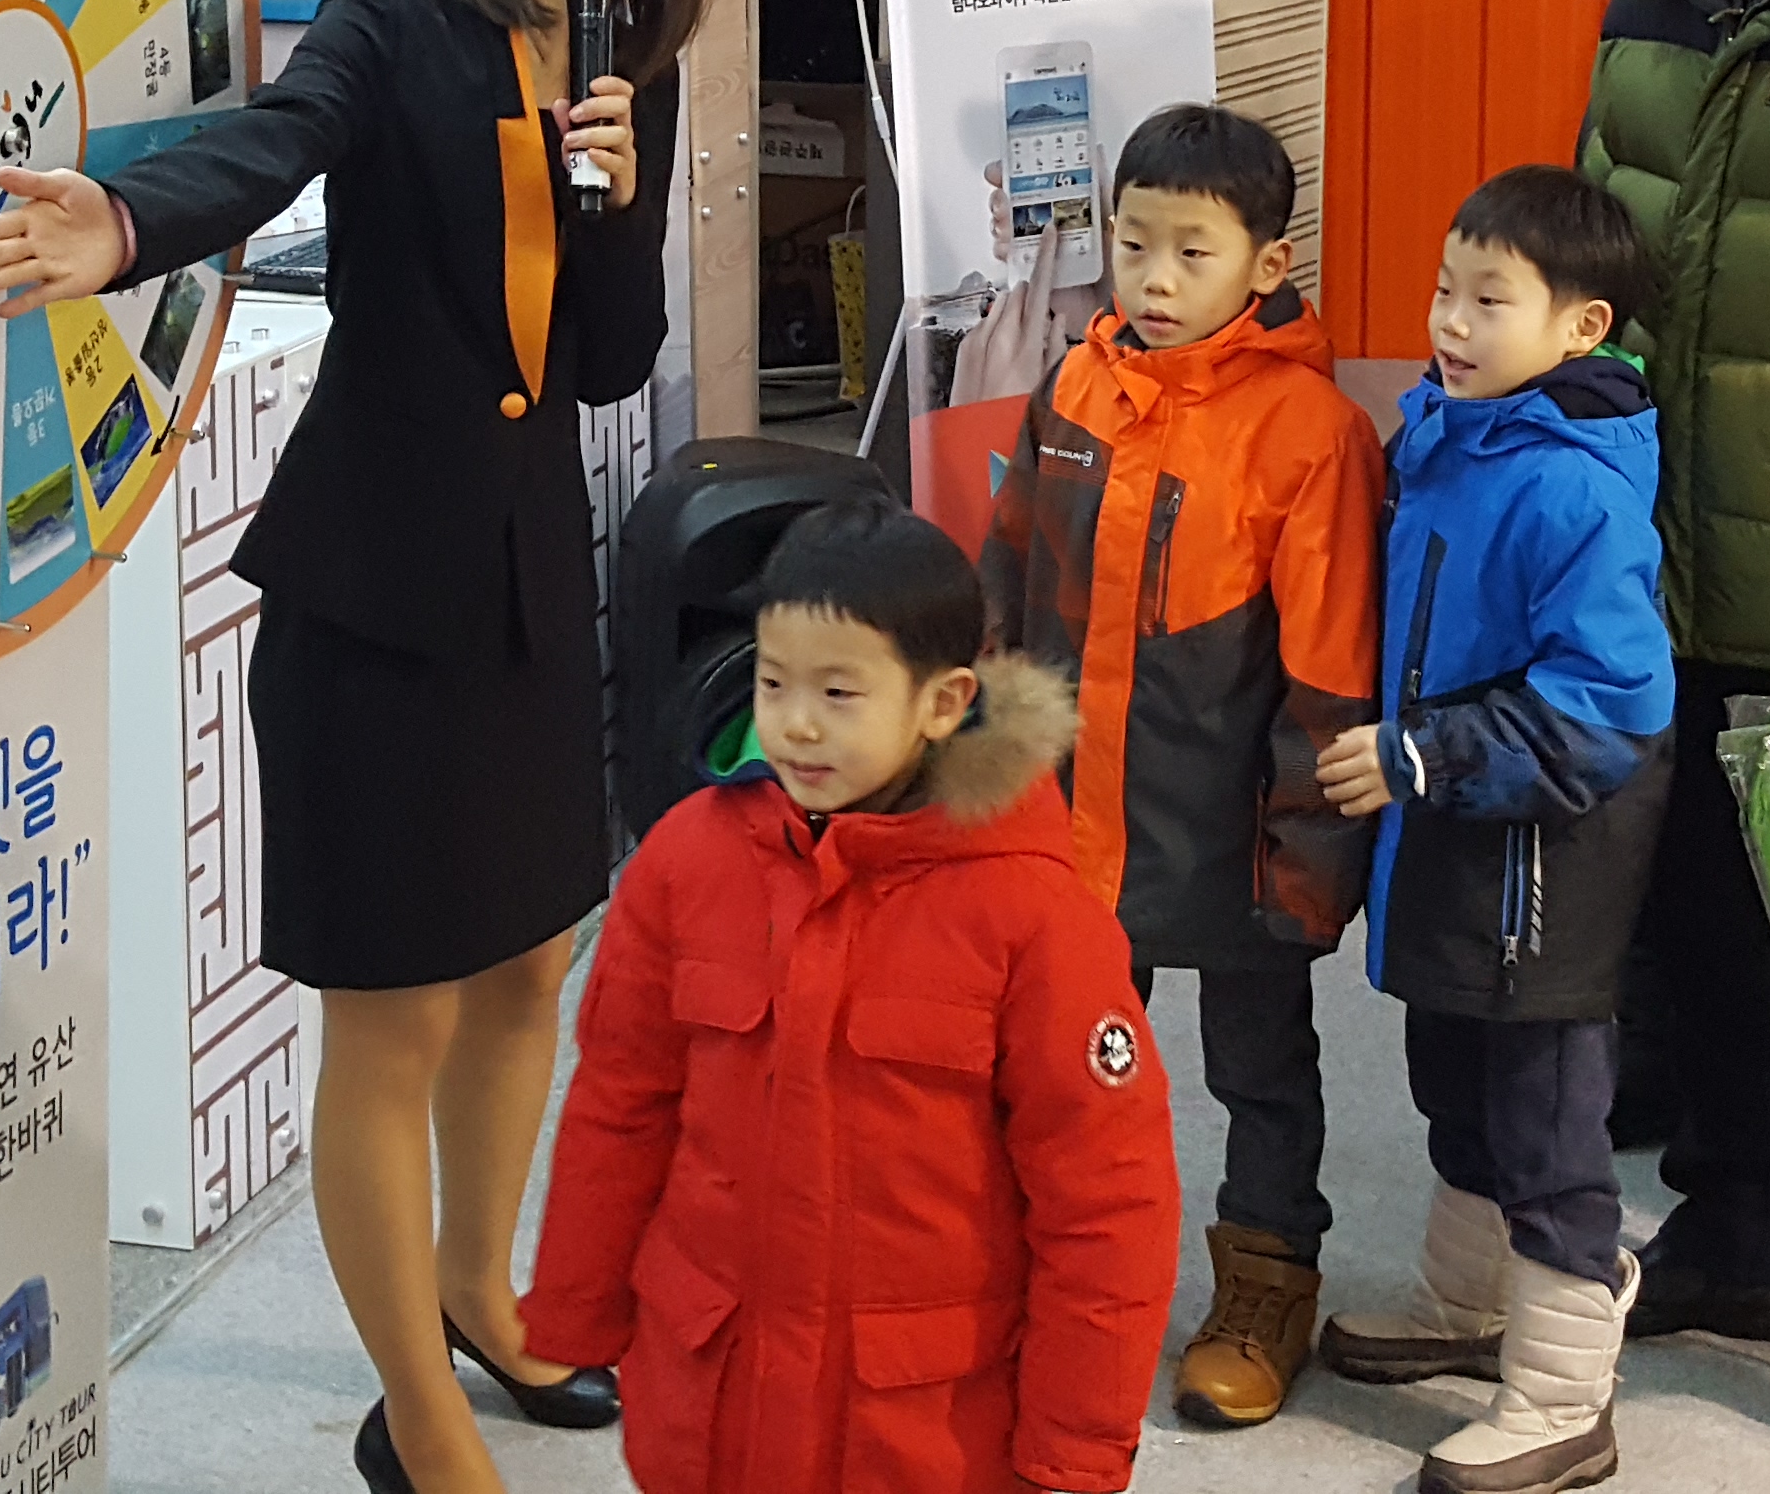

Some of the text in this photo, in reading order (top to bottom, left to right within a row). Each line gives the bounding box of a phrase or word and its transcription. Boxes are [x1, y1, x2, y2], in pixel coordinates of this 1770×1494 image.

[26, 1014, 77, 1089] 유산
[16, 1417, 56, 1465] CITY
[59, 1382, 97, 1428] TOUR
